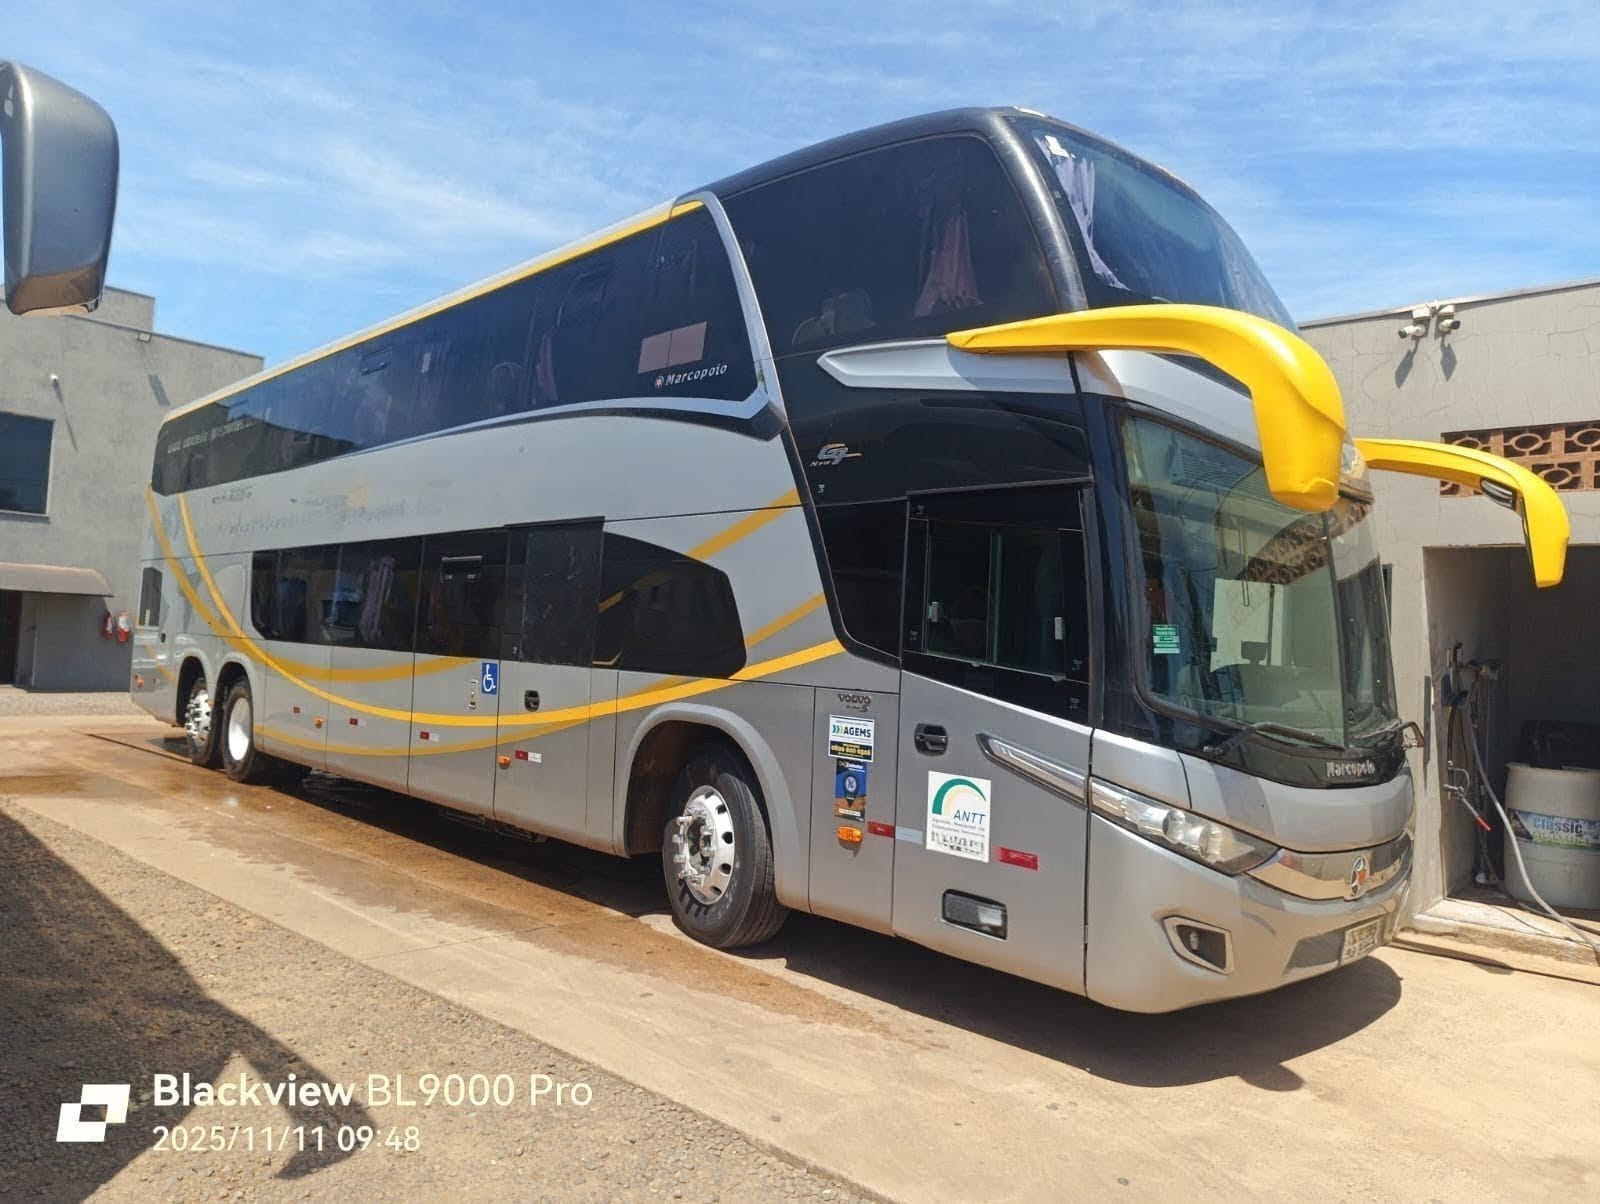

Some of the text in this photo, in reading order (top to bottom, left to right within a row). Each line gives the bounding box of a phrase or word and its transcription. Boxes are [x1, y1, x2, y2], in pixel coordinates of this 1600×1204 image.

[838, 693, 871, 705] VOLVO
[843, 726, 872, 738] AGEMS
[953, 809, 986, 825] ANTT
